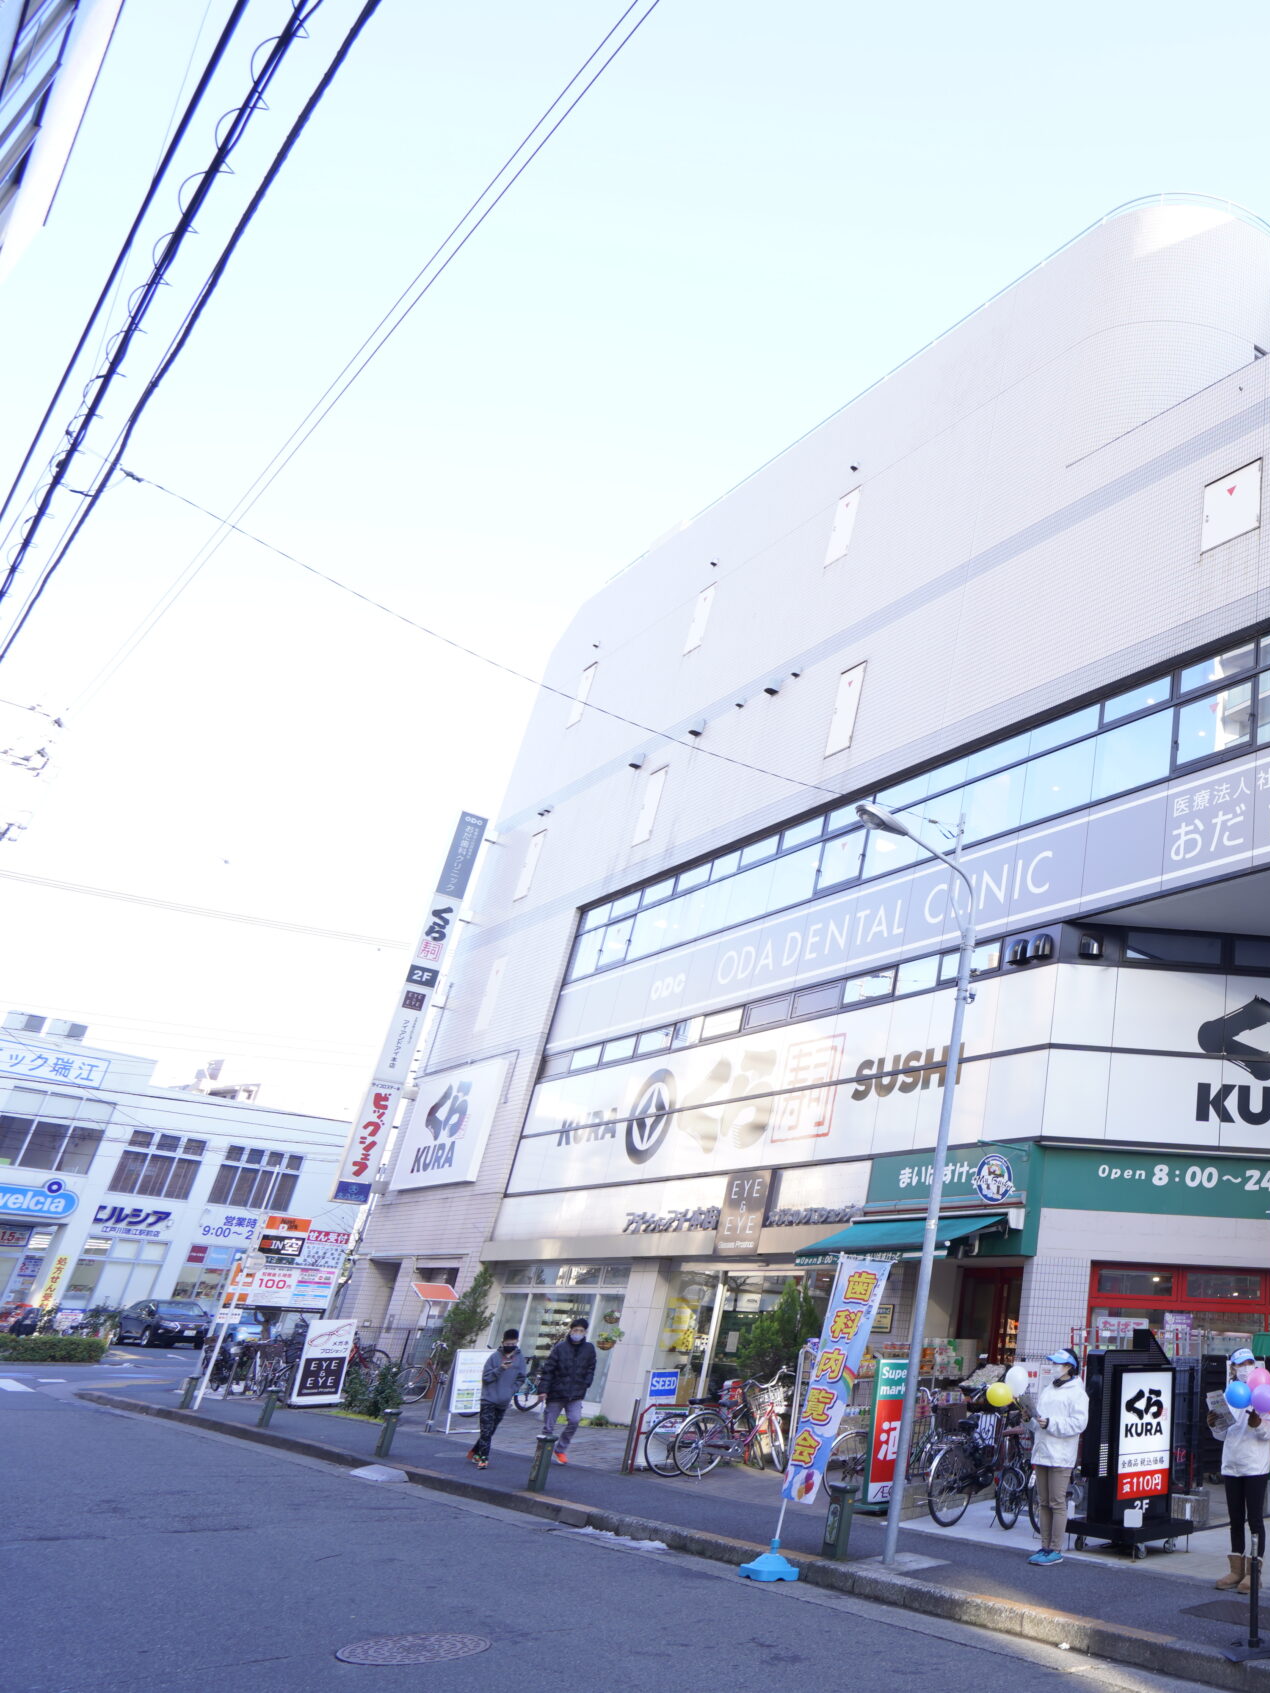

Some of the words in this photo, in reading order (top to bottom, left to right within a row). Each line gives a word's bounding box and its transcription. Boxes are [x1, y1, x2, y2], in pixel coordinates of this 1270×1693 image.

[425, 906, 454, 942] くら
[717, 951, 775, 985] ODA
[782, 898, 904, 967] DENTAL
[412, 970, 432, 982] 2F
[650, 973, 686, 1000] ODC
[0, 1049, 100, 1082] ック瑞江
[851, 1041, 966, 1101] SUSHI
[425, 1081, 472, 1141] くら
[352, 1092, 392, 1177] ビッグシェフ
[557, 1107, 618, 1147] KURA
[410, 1141, 456, 1174] KURA
[1098, 1165, 1147, 1180] Open
[731, 1179, 763, 1199] EYE
[739, 1201, 746, 1212] &
[223, 1215, 258, 1230] 営業時
[724, 1215, 756, 1235] EYE
[280, 1238, 302, 1255] 空
[308, 1230, 349, 1244] せん受付
[310, 1360, 340, 1370] EYE
[306, 1376, 336, 1387] EYE
[651, 1377, 677, 1390] SEED
[1125, 1388, 1163, 1421] くら
[1124, 1421, 1164, 1439] KURA
